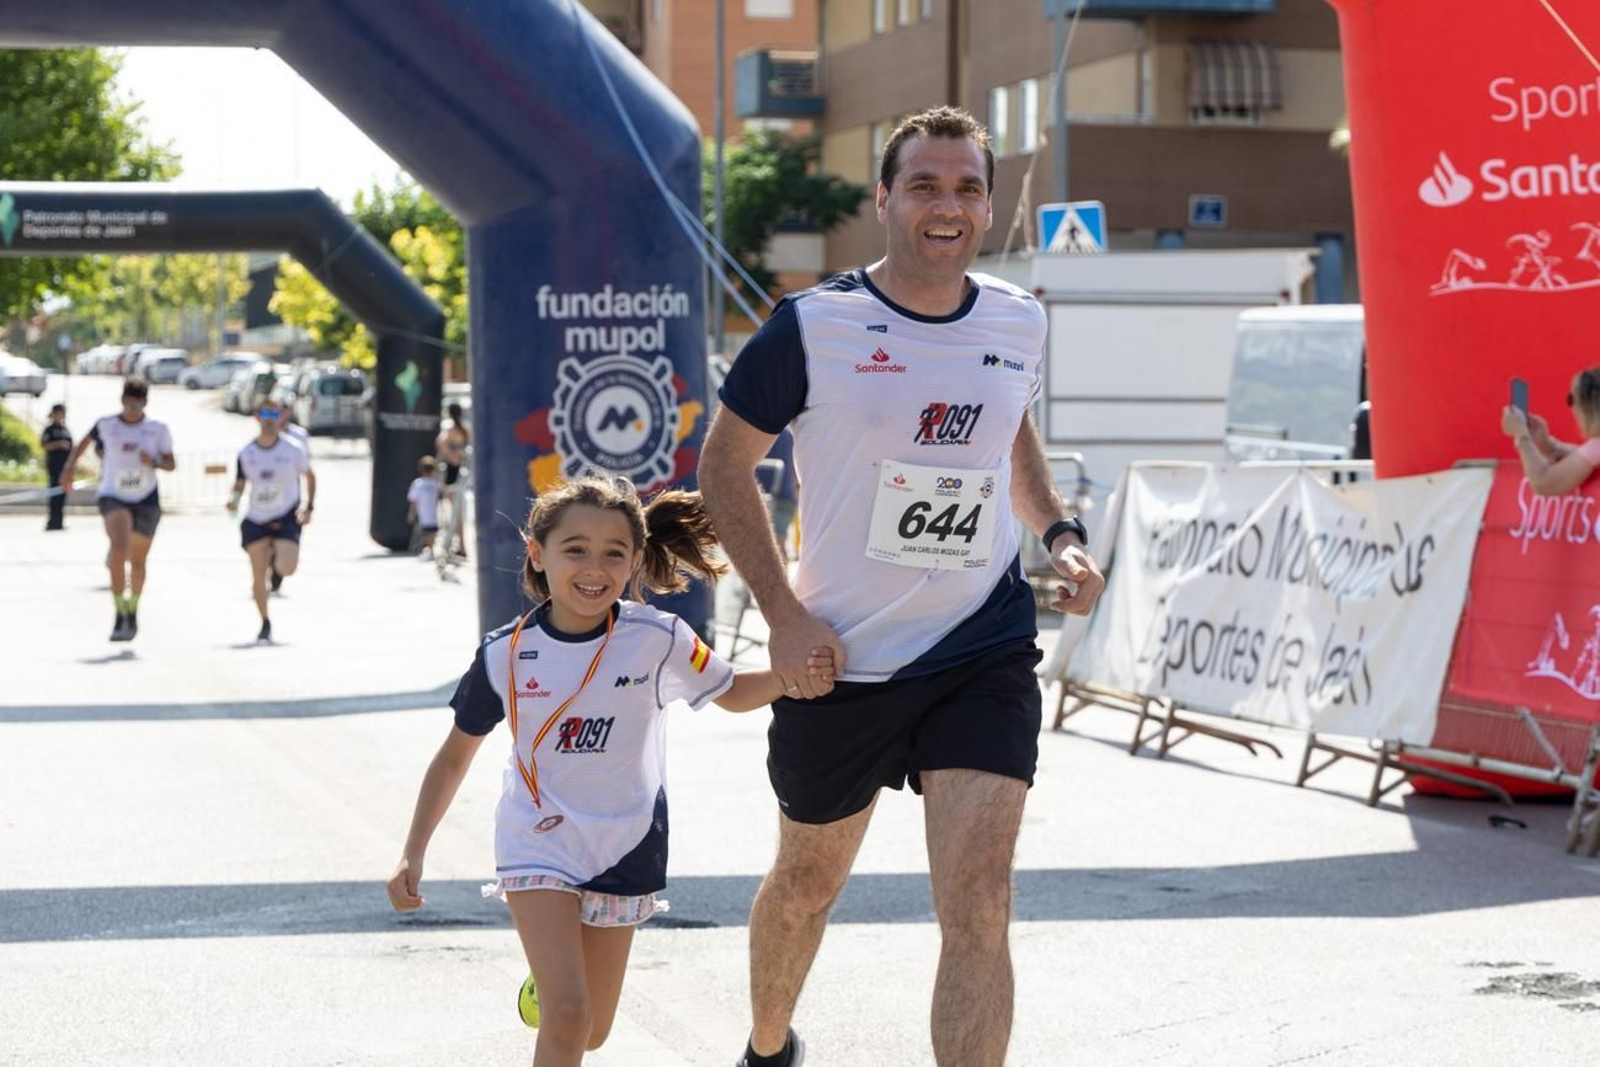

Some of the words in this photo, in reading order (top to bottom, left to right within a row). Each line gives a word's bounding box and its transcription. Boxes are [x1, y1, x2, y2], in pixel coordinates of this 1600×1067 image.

[1488, 77, 1600, 131] Spor
[535, 283, 690, 319] fundación
[565, 318, 666, 357] mupol
[855, 363, 907, 374] Santander
[898, 501, 983, 543] 644
[901, 545, 916, 553] JUAN
[917, 546, 939, 555] CARLOS
